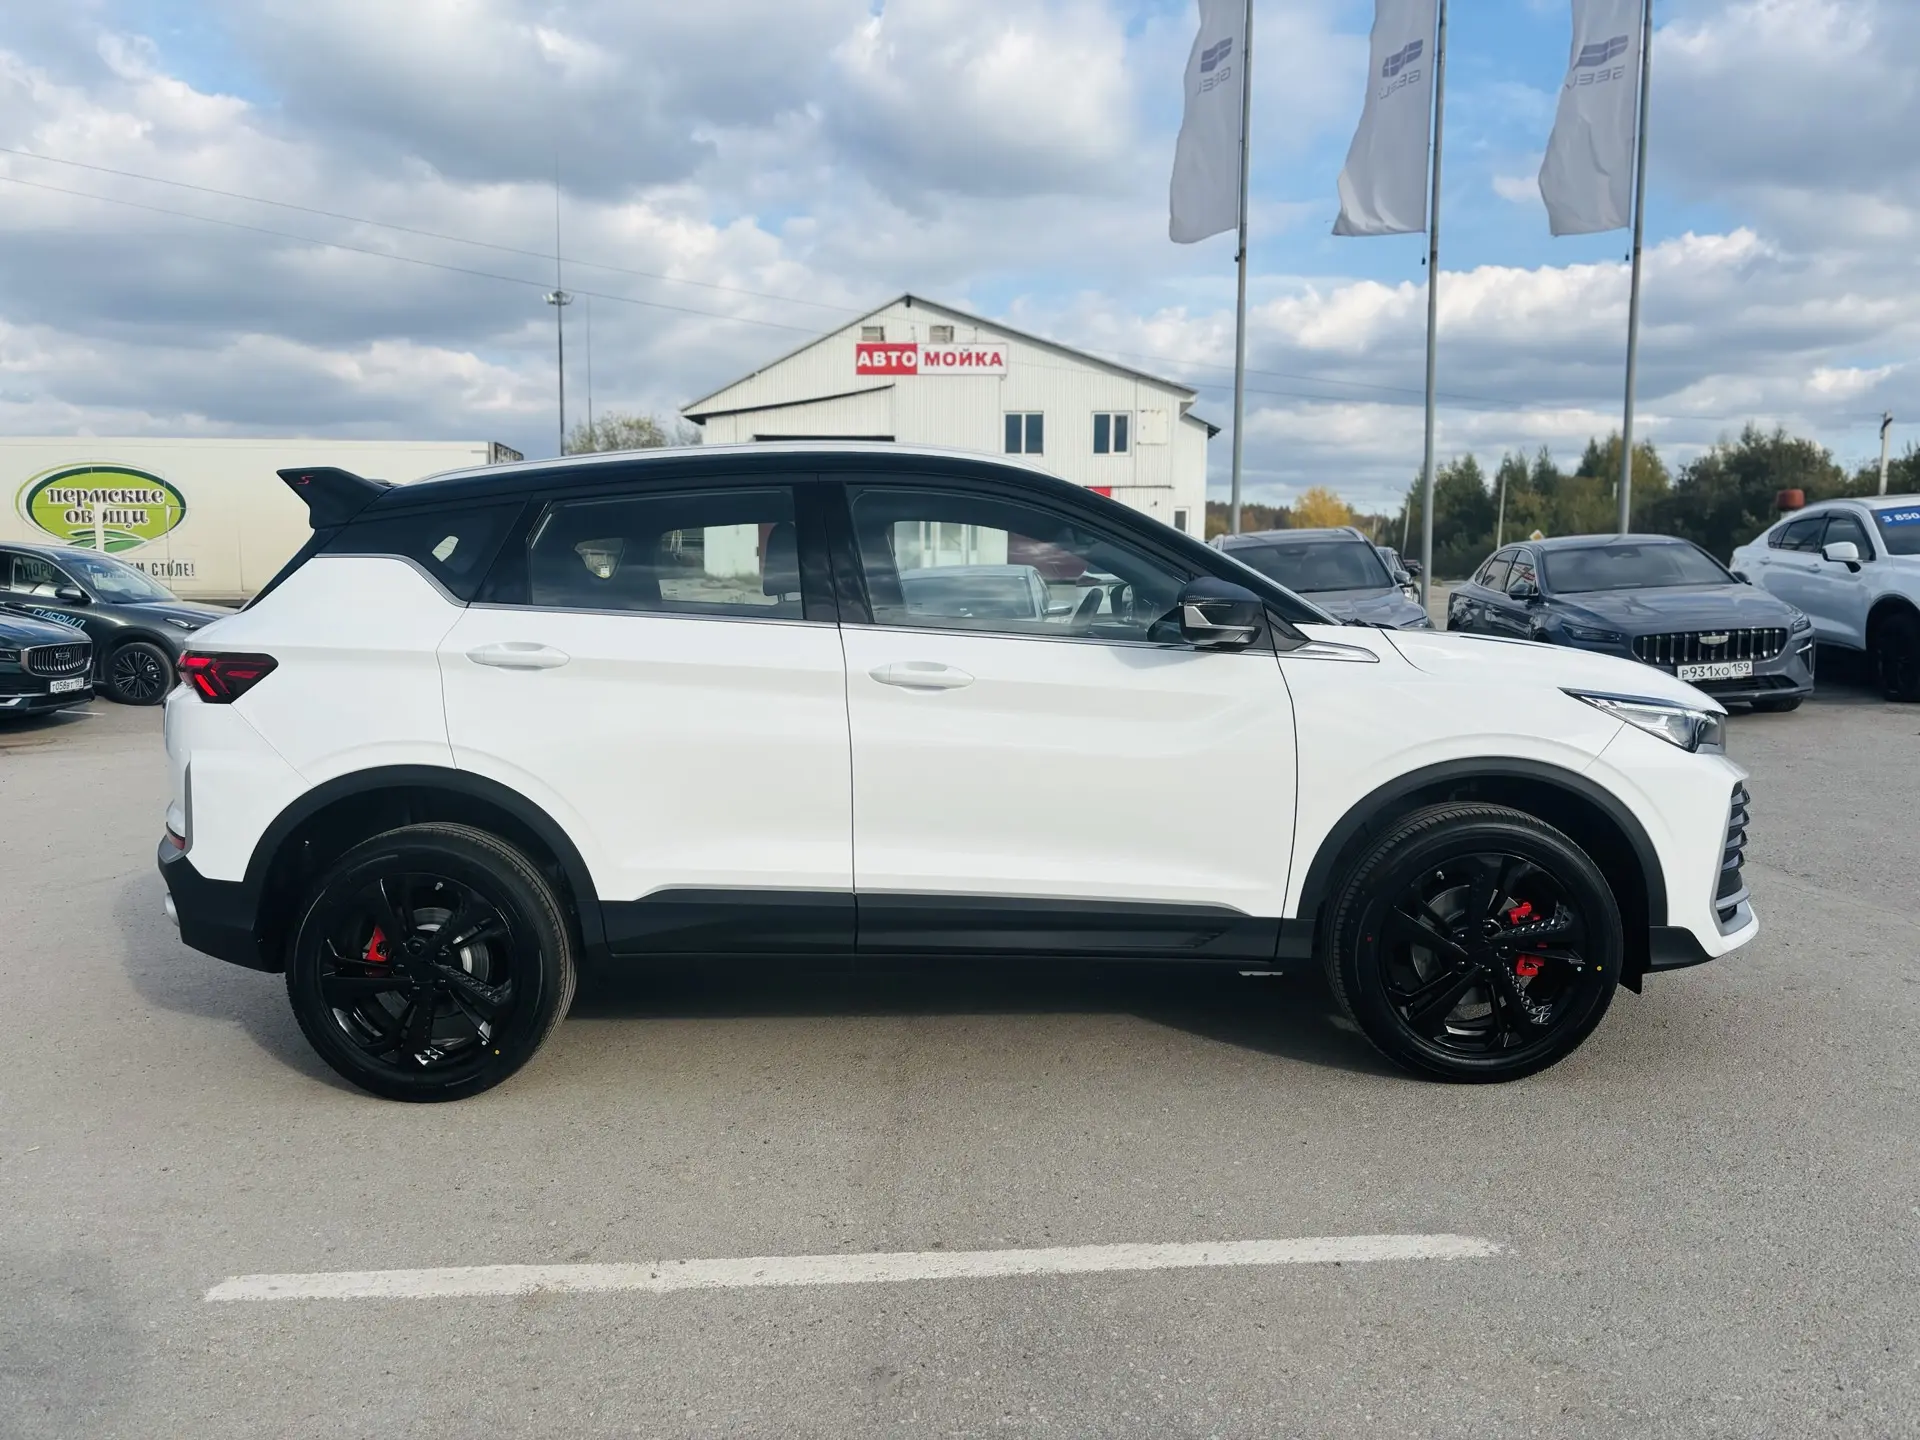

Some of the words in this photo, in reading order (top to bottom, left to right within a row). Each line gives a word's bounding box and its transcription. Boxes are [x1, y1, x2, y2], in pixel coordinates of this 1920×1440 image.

[857, 351, 917, 367] АВТО
[924, 348, 1003, 367] МОЙКА
[47, 488, 164, 507] пермские
[1882, 515, 1892, 523] 3
[1681, 665, 1730, 678] Р931ХО
[1731, 662, 1750, 673] 159
